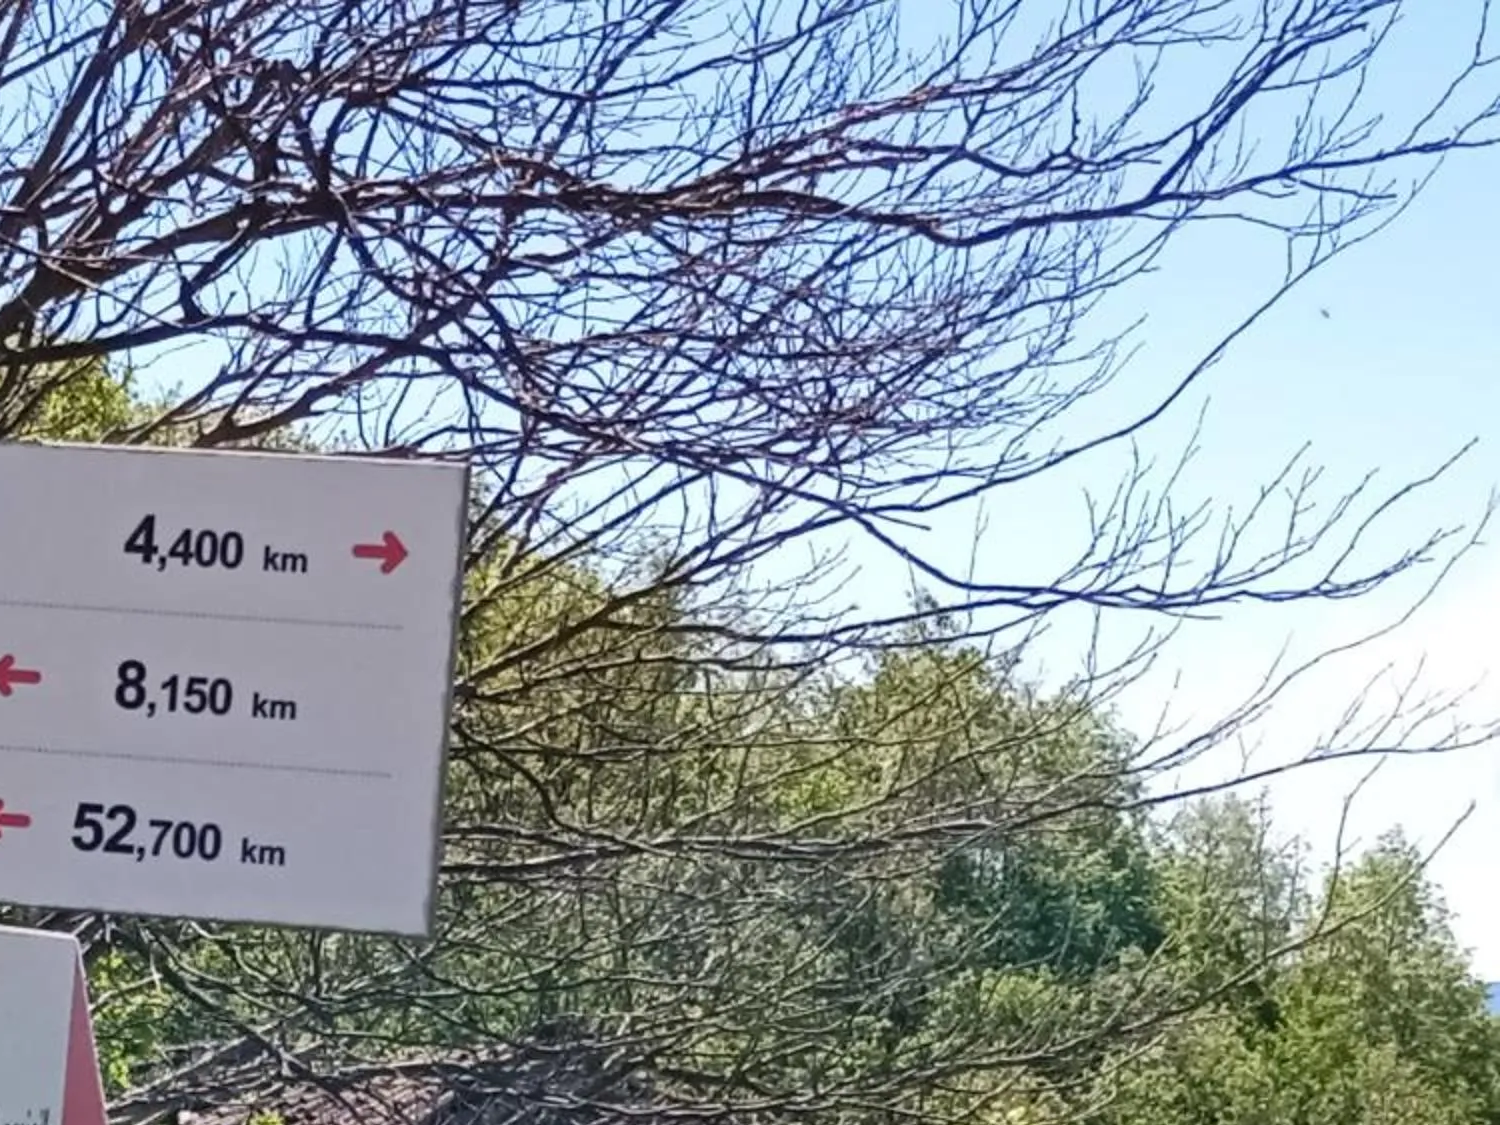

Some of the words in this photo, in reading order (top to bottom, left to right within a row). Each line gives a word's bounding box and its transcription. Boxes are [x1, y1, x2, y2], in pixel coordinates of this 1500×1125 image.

[124, 514, 244, 572] 4,400
[262, 545, 309, 574] km
[114, 659, 233, 718] 8,150
[250, 692, 297, 720] km
[71, 803, 223, 865] 52,700
[240, 836, 286, 866] km
